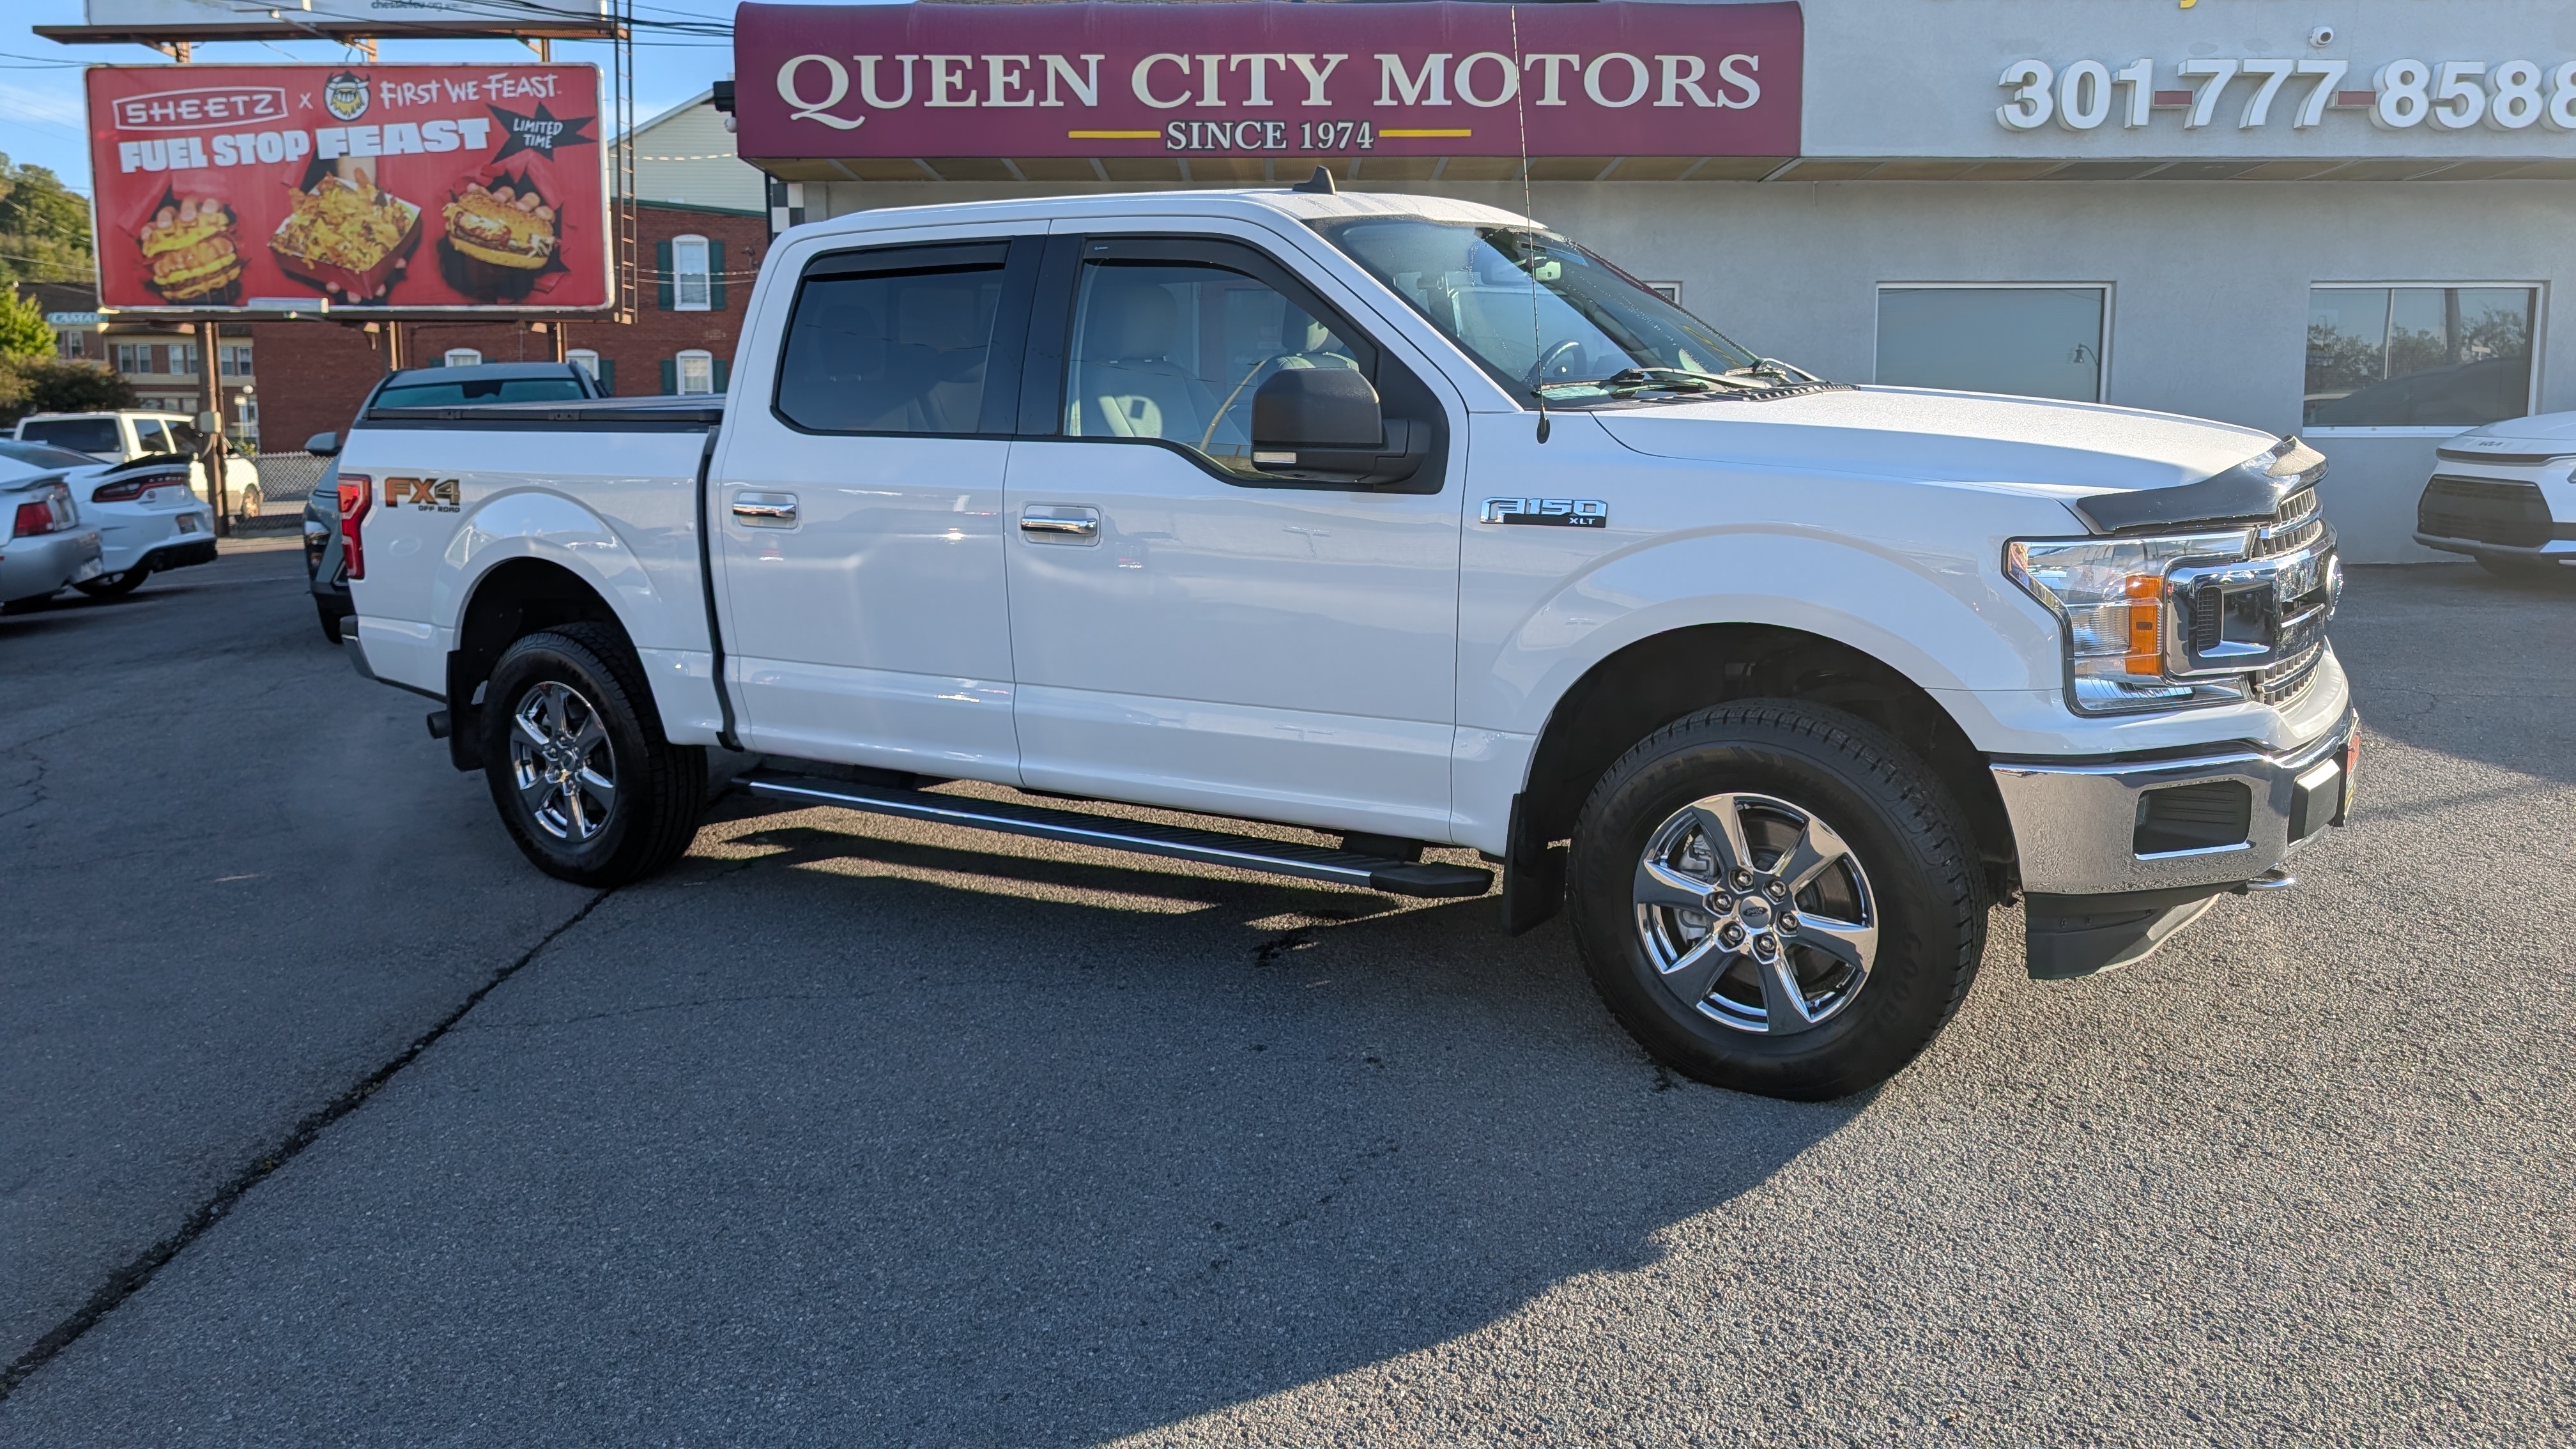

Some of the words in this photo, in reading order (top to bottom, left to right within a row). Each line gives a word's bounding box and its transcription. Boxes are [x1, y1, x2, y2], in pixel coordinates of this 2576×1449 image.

[379, 79, 441, 109] FIRST
[443, 77, 480, 103] WE
[482, 72, 559, 101] FEAST
[776, 53, 1105, 130] QUEEN
[1130, 52, 1349, 109] CITY
[1373, 52, 1761, 109] MOTORS
[125, 93, 275, 123] SHEETZ
[513, 118, 564, 135] LIMITED
[523, 133, 553, 150] TIME
[1165, 121, 1288, 151] SINCE
[1300, 121, 1375, 151] 1974
[118, 136, 209, 174] FUEL
[211, 129, 311, 167] STOP
[315, 118, 491, 160] FEAST
[385, 477, 460, 507] FX4
